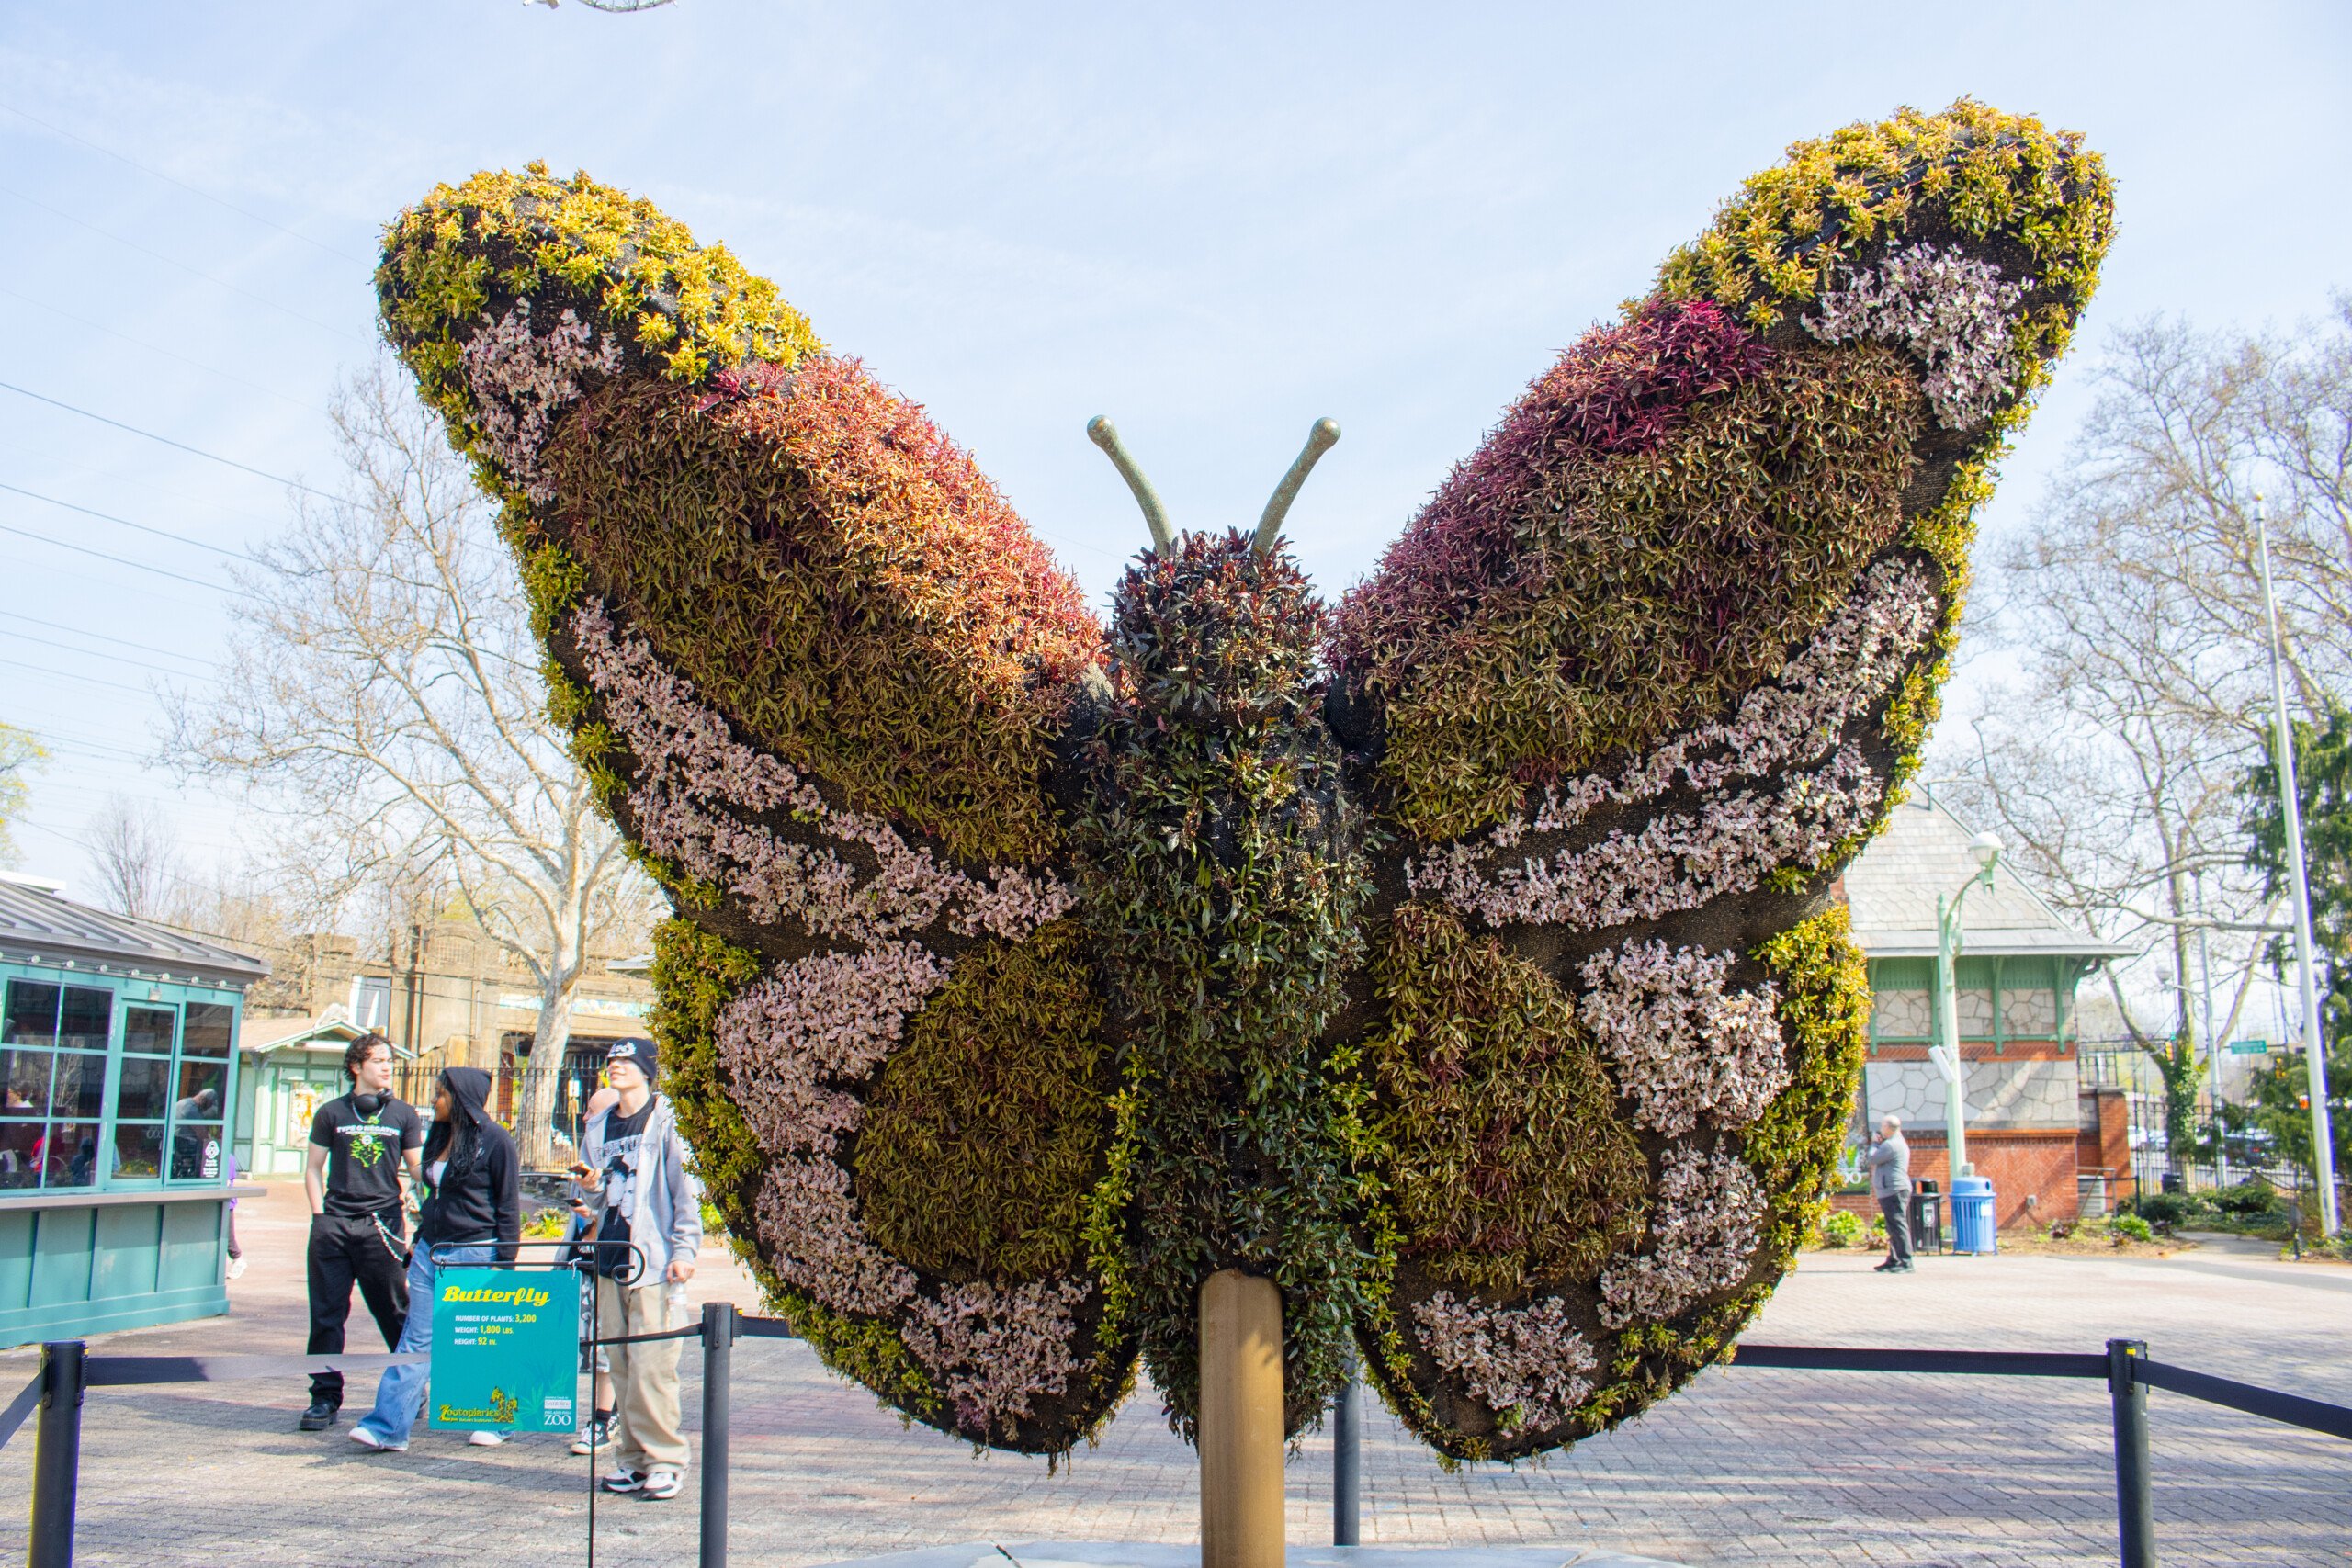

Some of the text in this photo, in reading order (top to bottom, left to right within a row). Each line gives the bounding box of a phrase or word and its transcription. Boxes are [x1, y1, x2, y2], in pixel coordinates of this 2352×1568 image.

[337, 1125, 356, 1134] TYPE
[442, 1285, 551, 1307] Butterfly
[514, 1314, 537, 1323] 3,200
[480, 1325, 501, 1335] 1,800
[544, 1415, 571, 1426] ZOO
